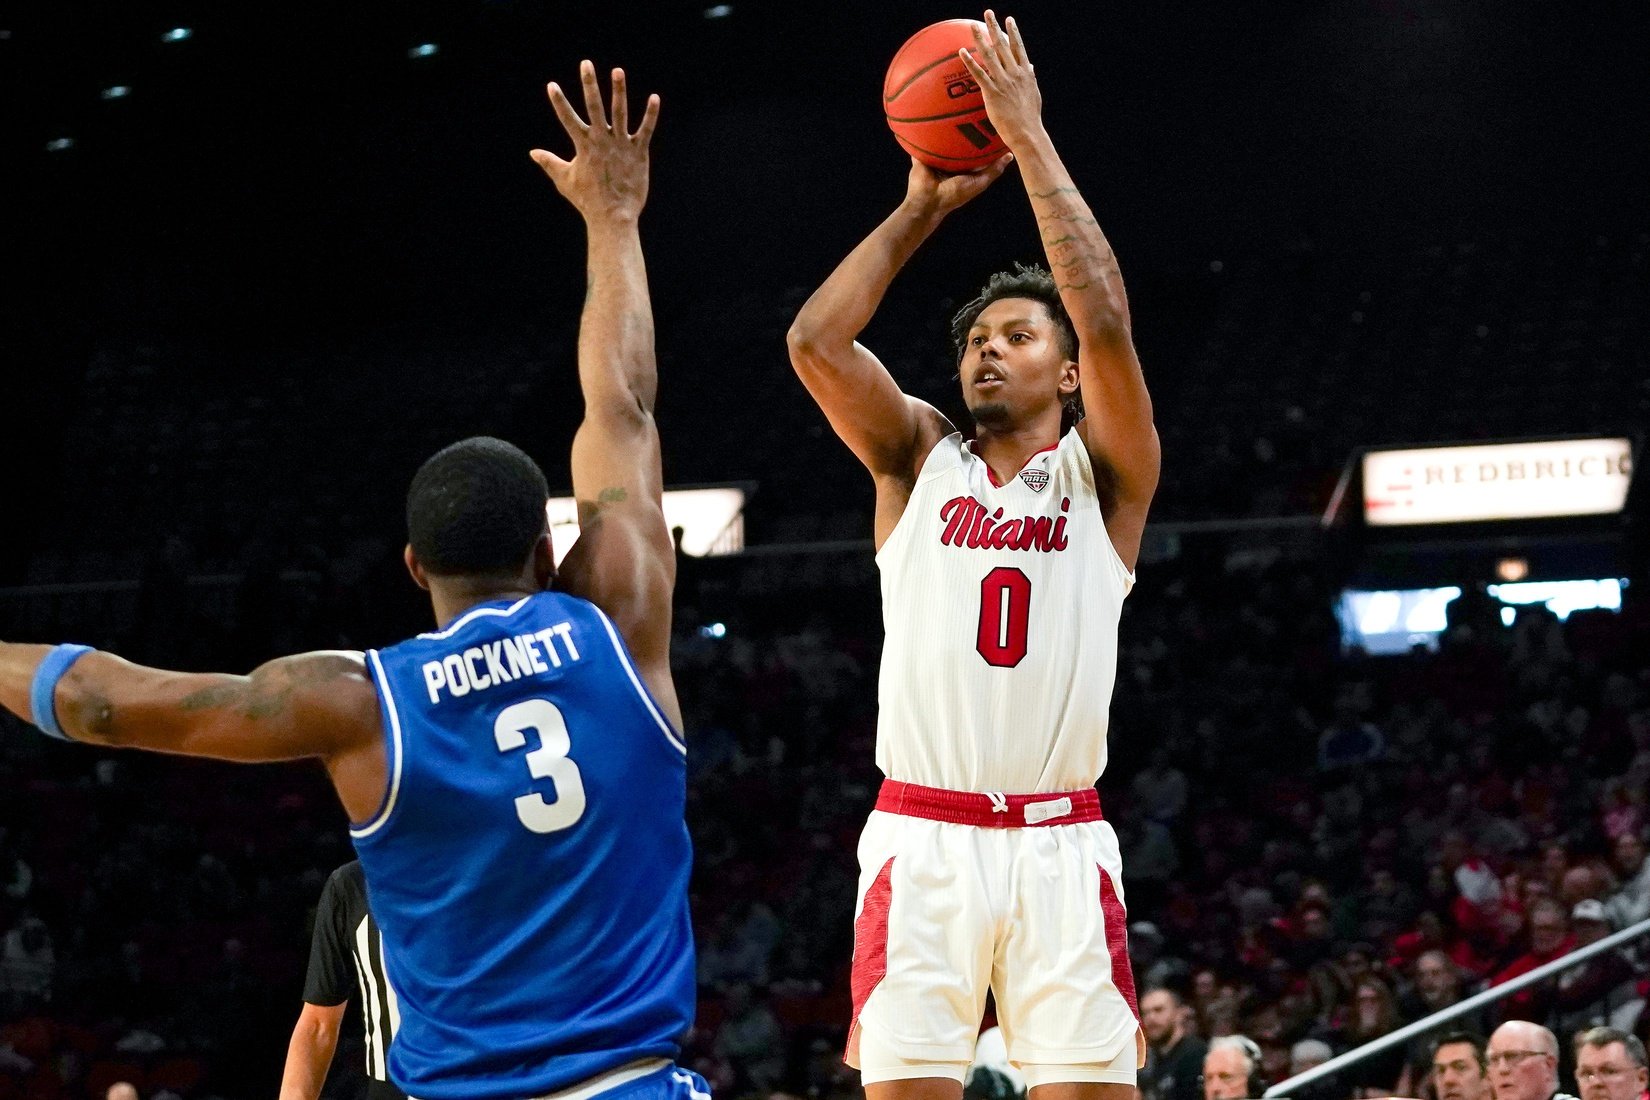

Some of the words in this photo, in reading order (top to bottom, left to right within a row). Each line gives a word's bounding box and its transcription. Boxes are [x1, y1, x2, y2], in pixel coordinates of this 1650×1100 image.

[940, 496, 1070, 552] Miami
[422, 622, 580, 704] POCKNETT
[976, 567, 1031, 668] 0
[494, 699, 586, 833] 3
